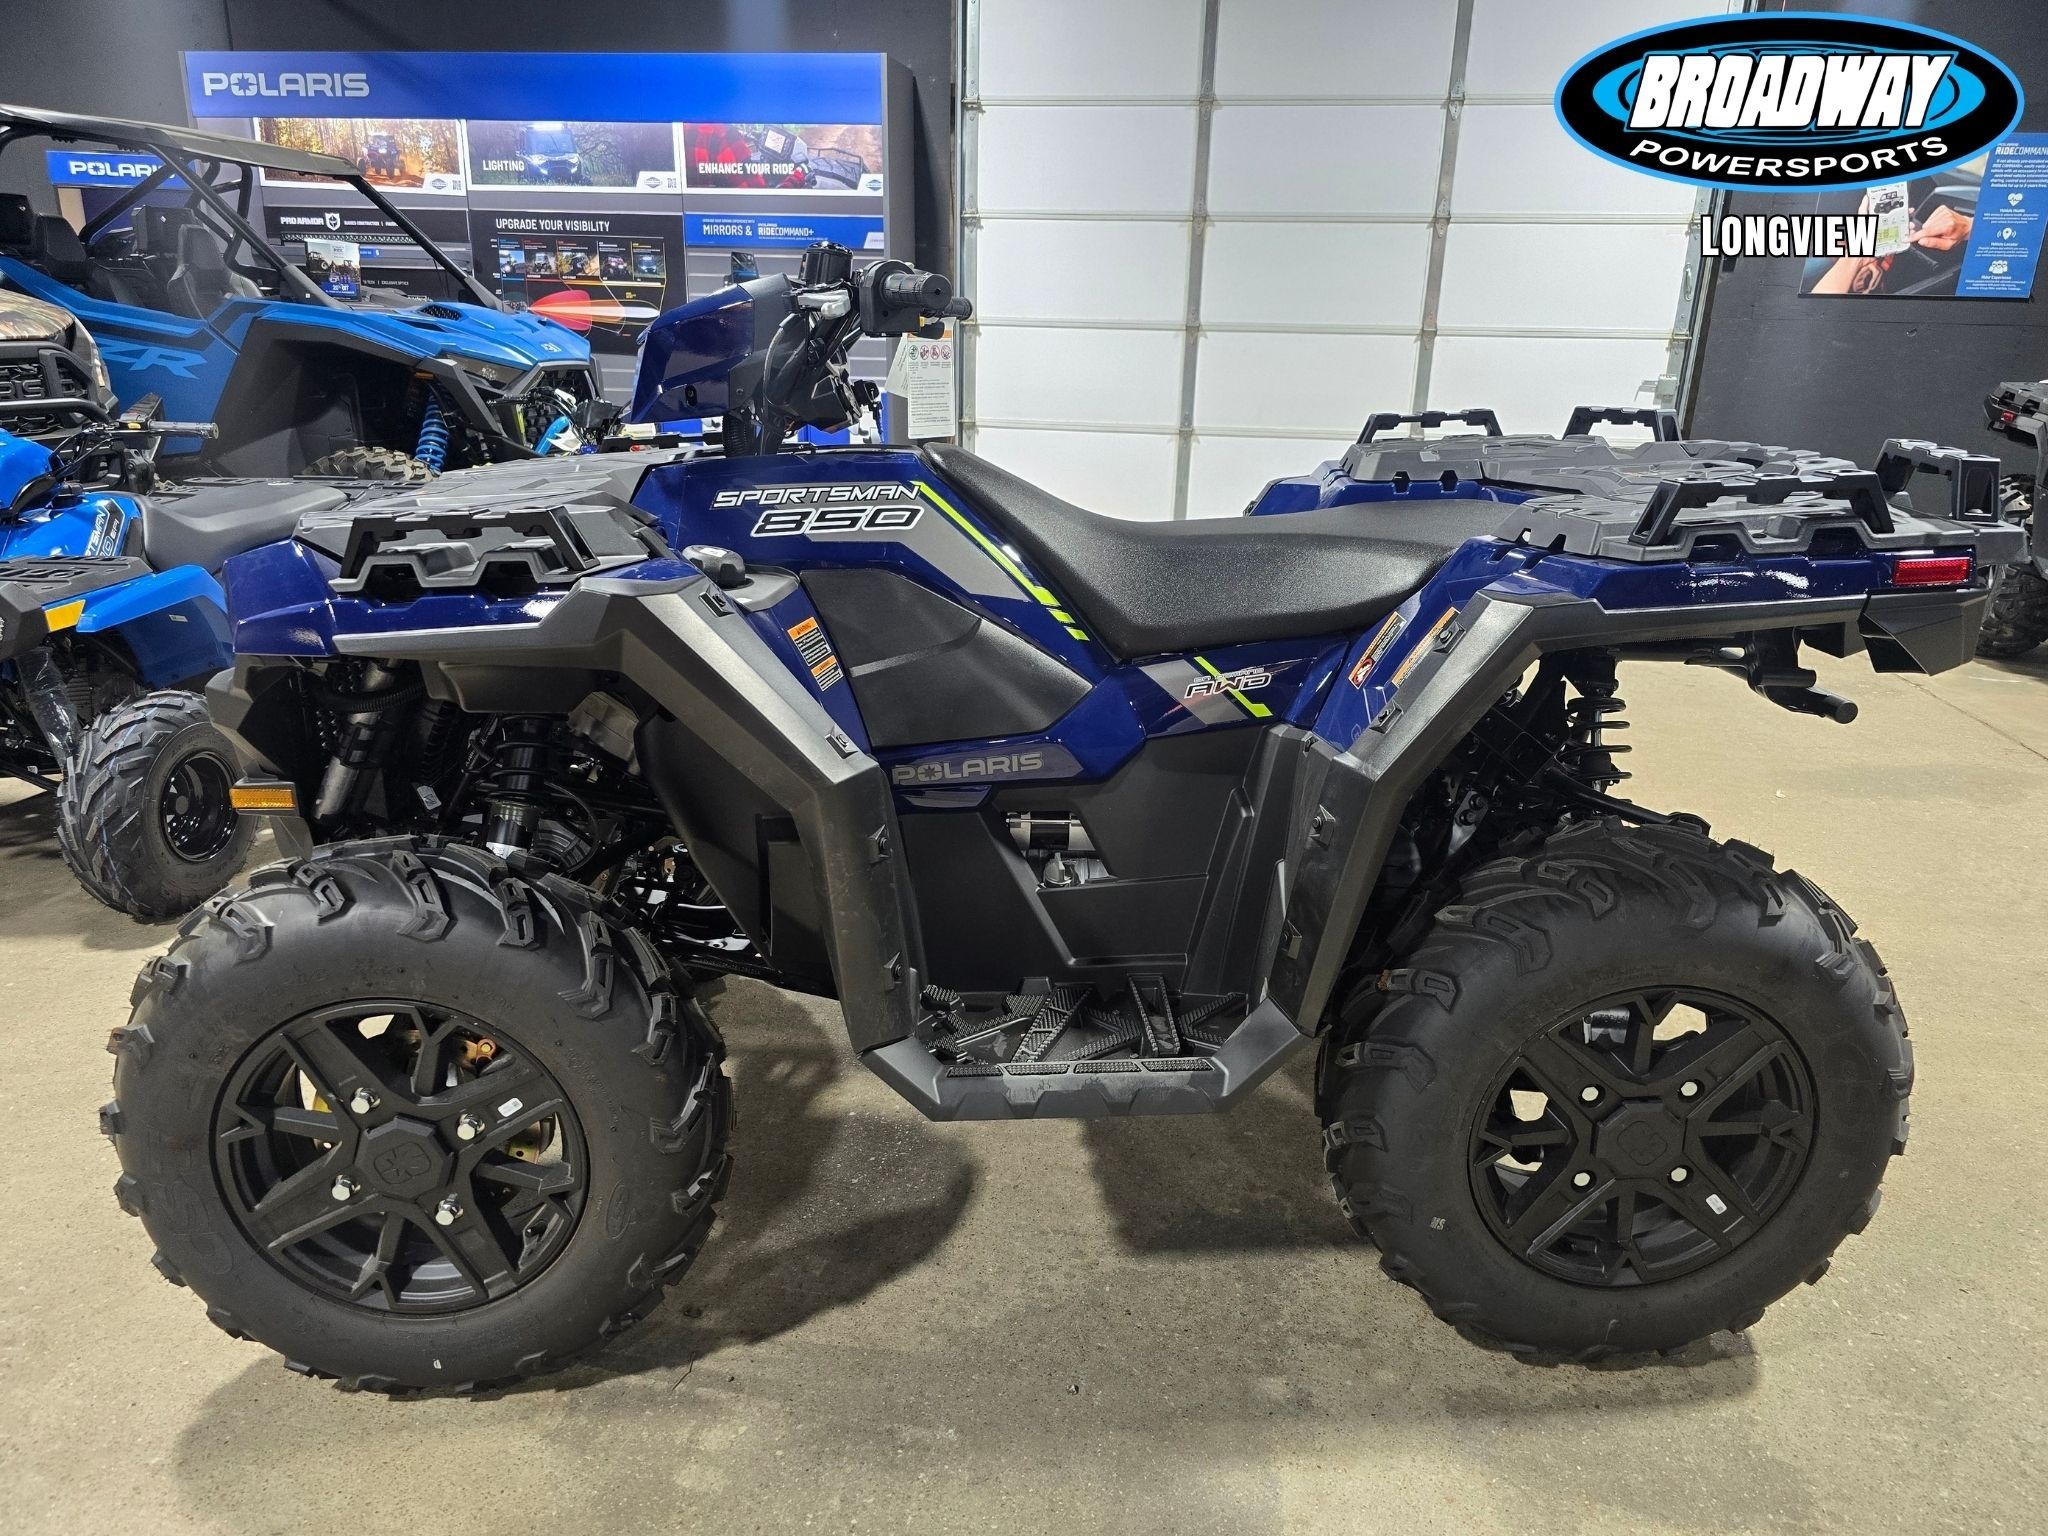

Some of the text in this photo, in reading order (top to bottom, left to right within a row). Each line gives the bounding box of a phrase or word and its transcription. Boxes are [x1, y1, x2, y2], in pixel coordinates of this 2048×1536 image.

[202, 72, 370, 97] POLARIS
[68, 161, 175, 179] POLARI
[482, 159, 525, 172] LIGHTING
[699, 163, 795, 175] ENHANCE YOUR RIDE
[495, 218, 610, 232] UPGRADE YOUR VISIBILITY
[702, 224, 753, 237] MIRRORS &
[757, 227, 815, 237] RIDECOMMAND+
[713, 485, 921, 508] SPORTSMAN
[750, 504, 925, 538] 850
[1183, 672, 1272, 699] AWD
[891, 752, 1043, 785] POLARIS
